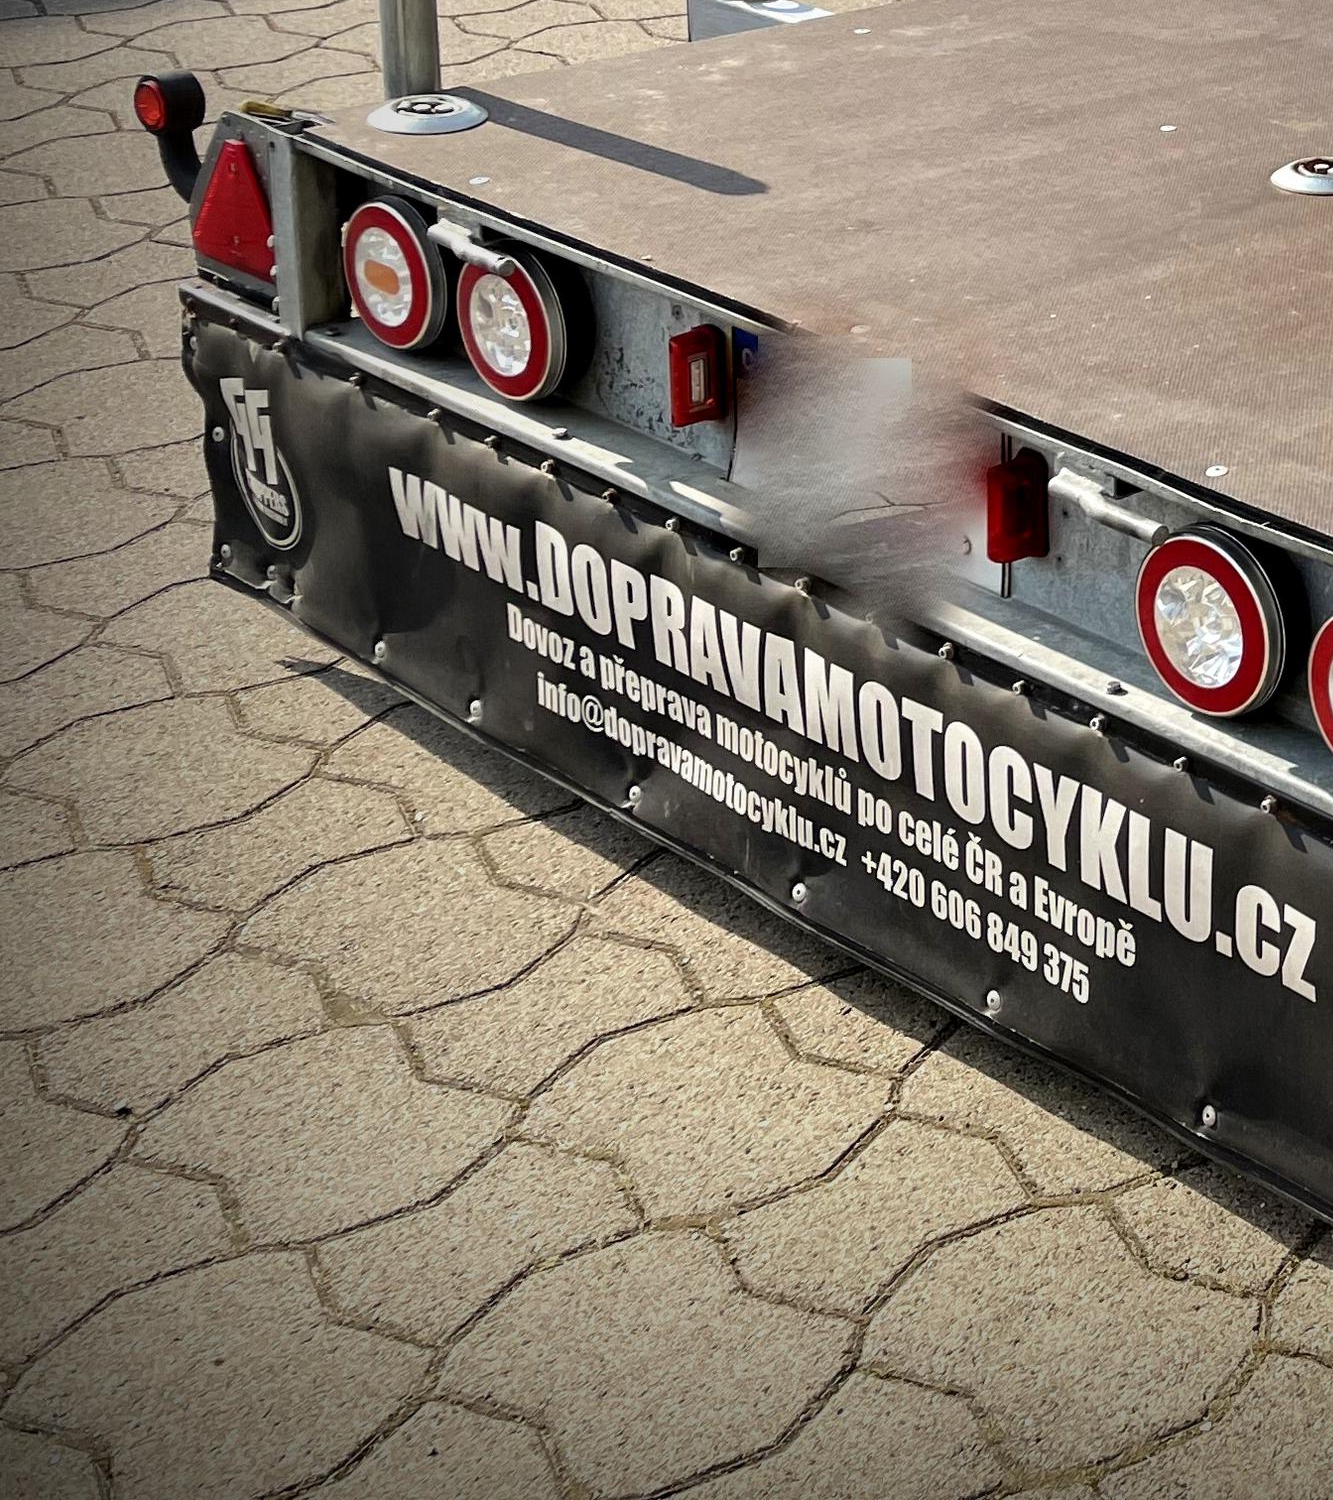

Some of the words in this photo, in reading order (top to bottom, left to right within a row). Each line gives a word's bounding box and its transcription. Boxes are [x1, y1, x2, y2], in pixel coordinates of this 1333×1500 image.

[388, 466, 1318, 1003] WWW.DOPRAVAMOTOCYKLU.CZ
[507, 603, 575, 667] Dovoz
[579, 646, 597, 679] a
[600, 653, 713, 741] přeprava
[716, 711, 852, 815] motocyklů
[857, 787, 892, 835] po
[899, 809, 960, 873] celé
[965, 832, 1003, 899] ČR
[1008, 873, 1028, 911] a
[1033, 875, 1137, 968] Evropě
[537, 672, 848, 867] info@dopravamotocyklu.cz
[861, 847, 926, 909] +420
[931, 879, 982, 941] 606
[986, 910, 1039, 973] 849
[1042, 942, 1092, 1005] 375
